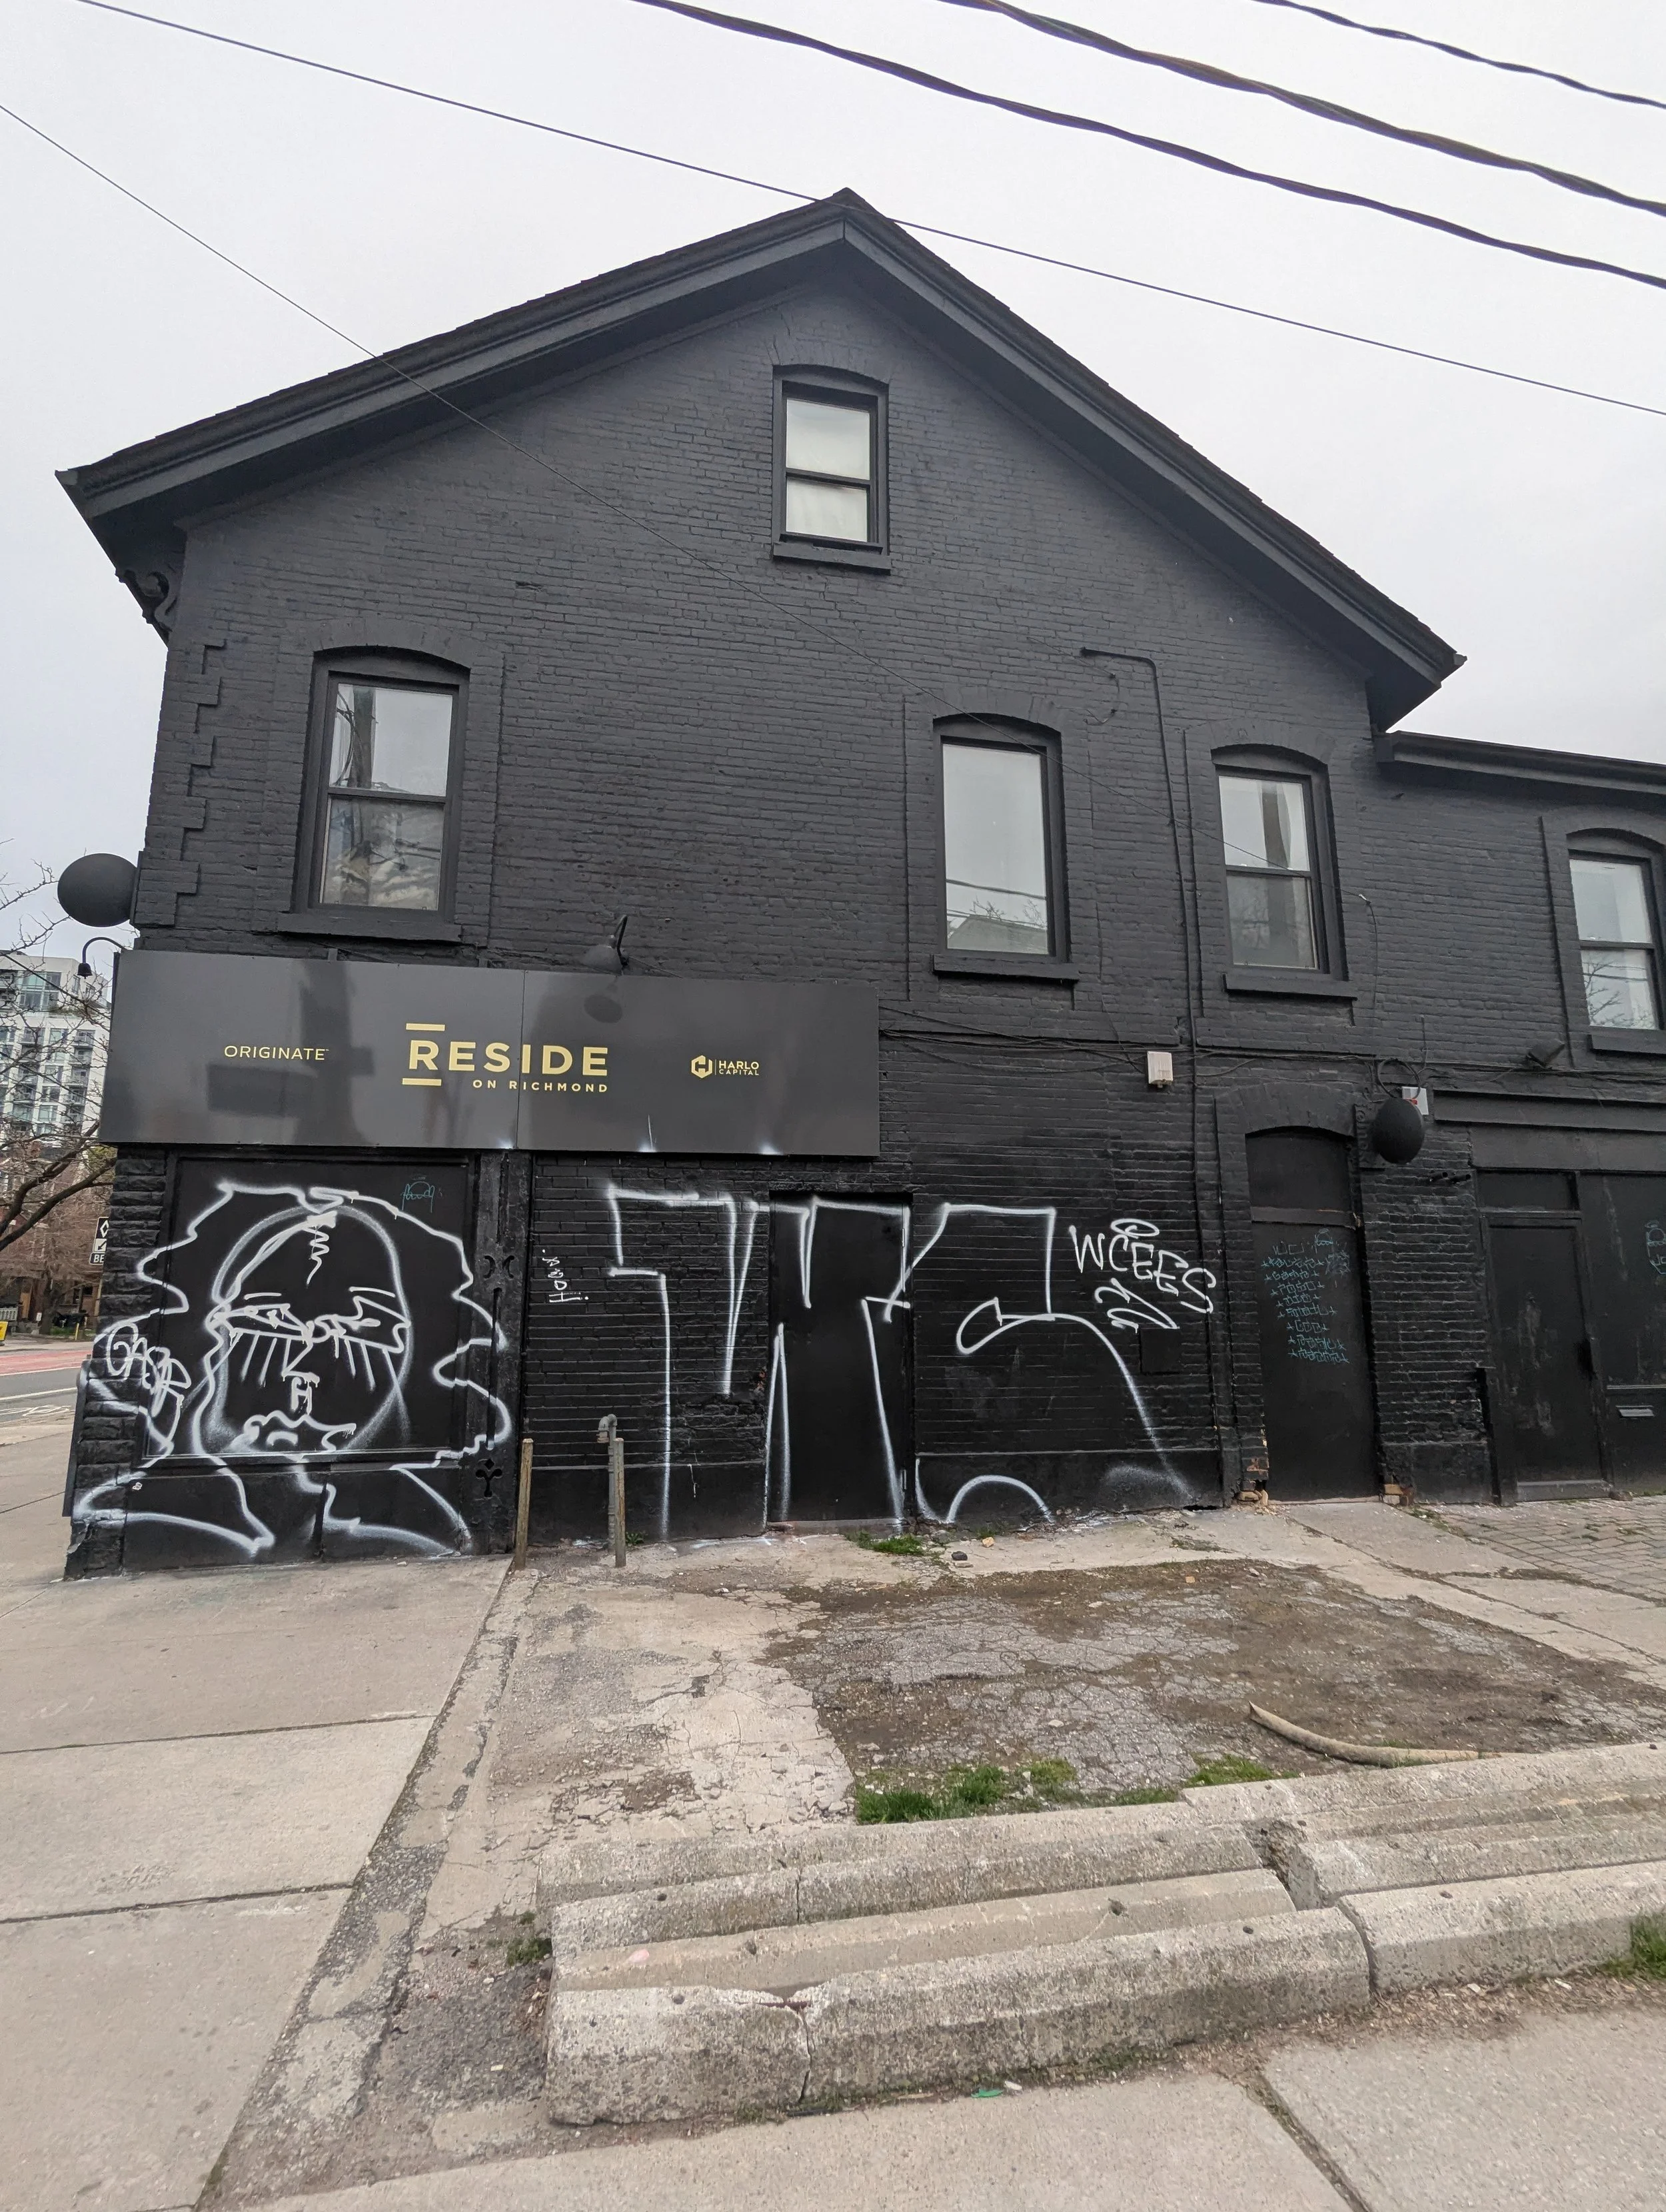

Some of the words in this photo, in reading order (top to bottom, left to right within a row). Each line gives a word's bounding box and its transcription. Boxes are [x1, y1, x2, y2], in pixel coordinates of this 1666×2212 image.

[224, 1045, 326, 1061] ORIGINATE
[409, 1039, 608, 1076] RESIDE
[718, 1060, 760, 1070] HARLO
[472, 1079, 496, 1089] ON
[508, 1080, 608, 1093] RICHMOND
